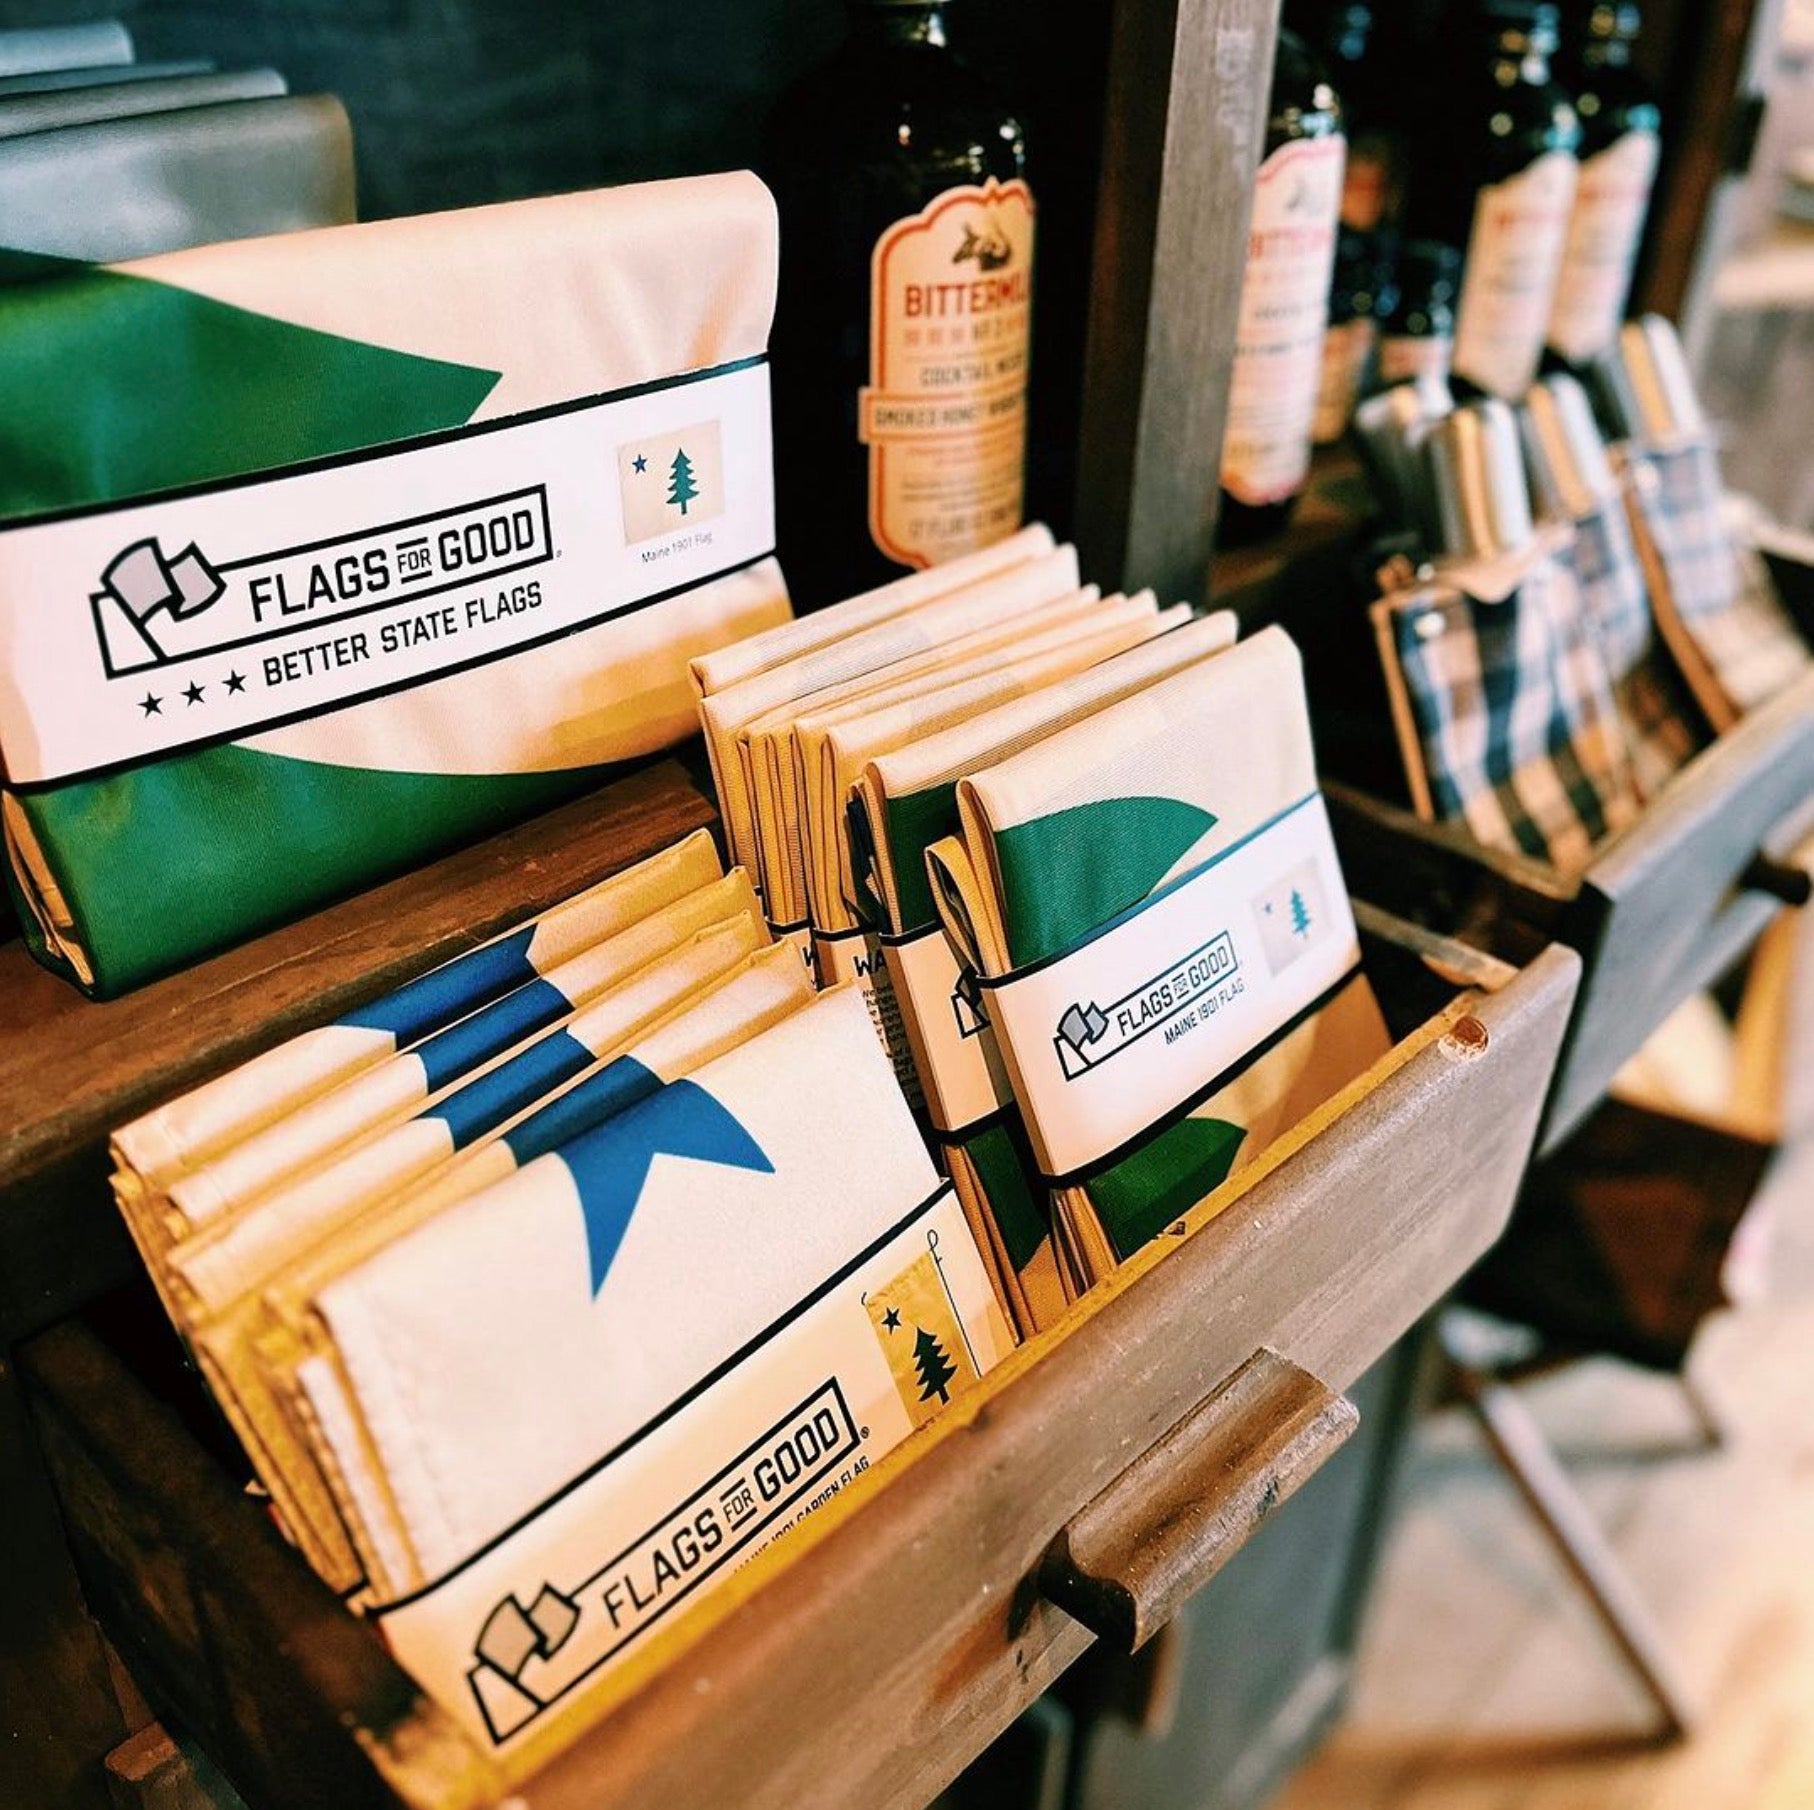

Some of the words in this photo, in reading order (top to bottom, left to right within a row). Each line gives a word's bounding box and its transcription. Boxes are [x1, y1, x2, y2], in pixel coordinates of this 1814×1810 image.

[248, 548, 390, 623] FLAGS
[396, 548, 432, 573] FOR
[437, 508, 535, 572] GOOD
[672, 536, 692, 553] 1901
[694, 531, 713, 546] Flag
[262, 632, 370, 687] BETTER
[380, 606, 459, 653] STATE
[464, 580, 542, 629] FLAGS
[1116, 983, 1174, 1037] FLAGS
[1173, 977, 1188, 996] FOR
[1187, 944, 1229, 989] GOOD
[1163, 1011, 1198, 1046] MAINE
[1197, 996, 1220, 1021] 1901
[1218, 977, 1246, 1006] FLAG
[839, 1455, 870, 1486] FLAG
[601, 1506, 723, 1630] FLAGS
[722, 1487, 755, 1524] FOR
[752, 1407, 840, 1502] GOOD
